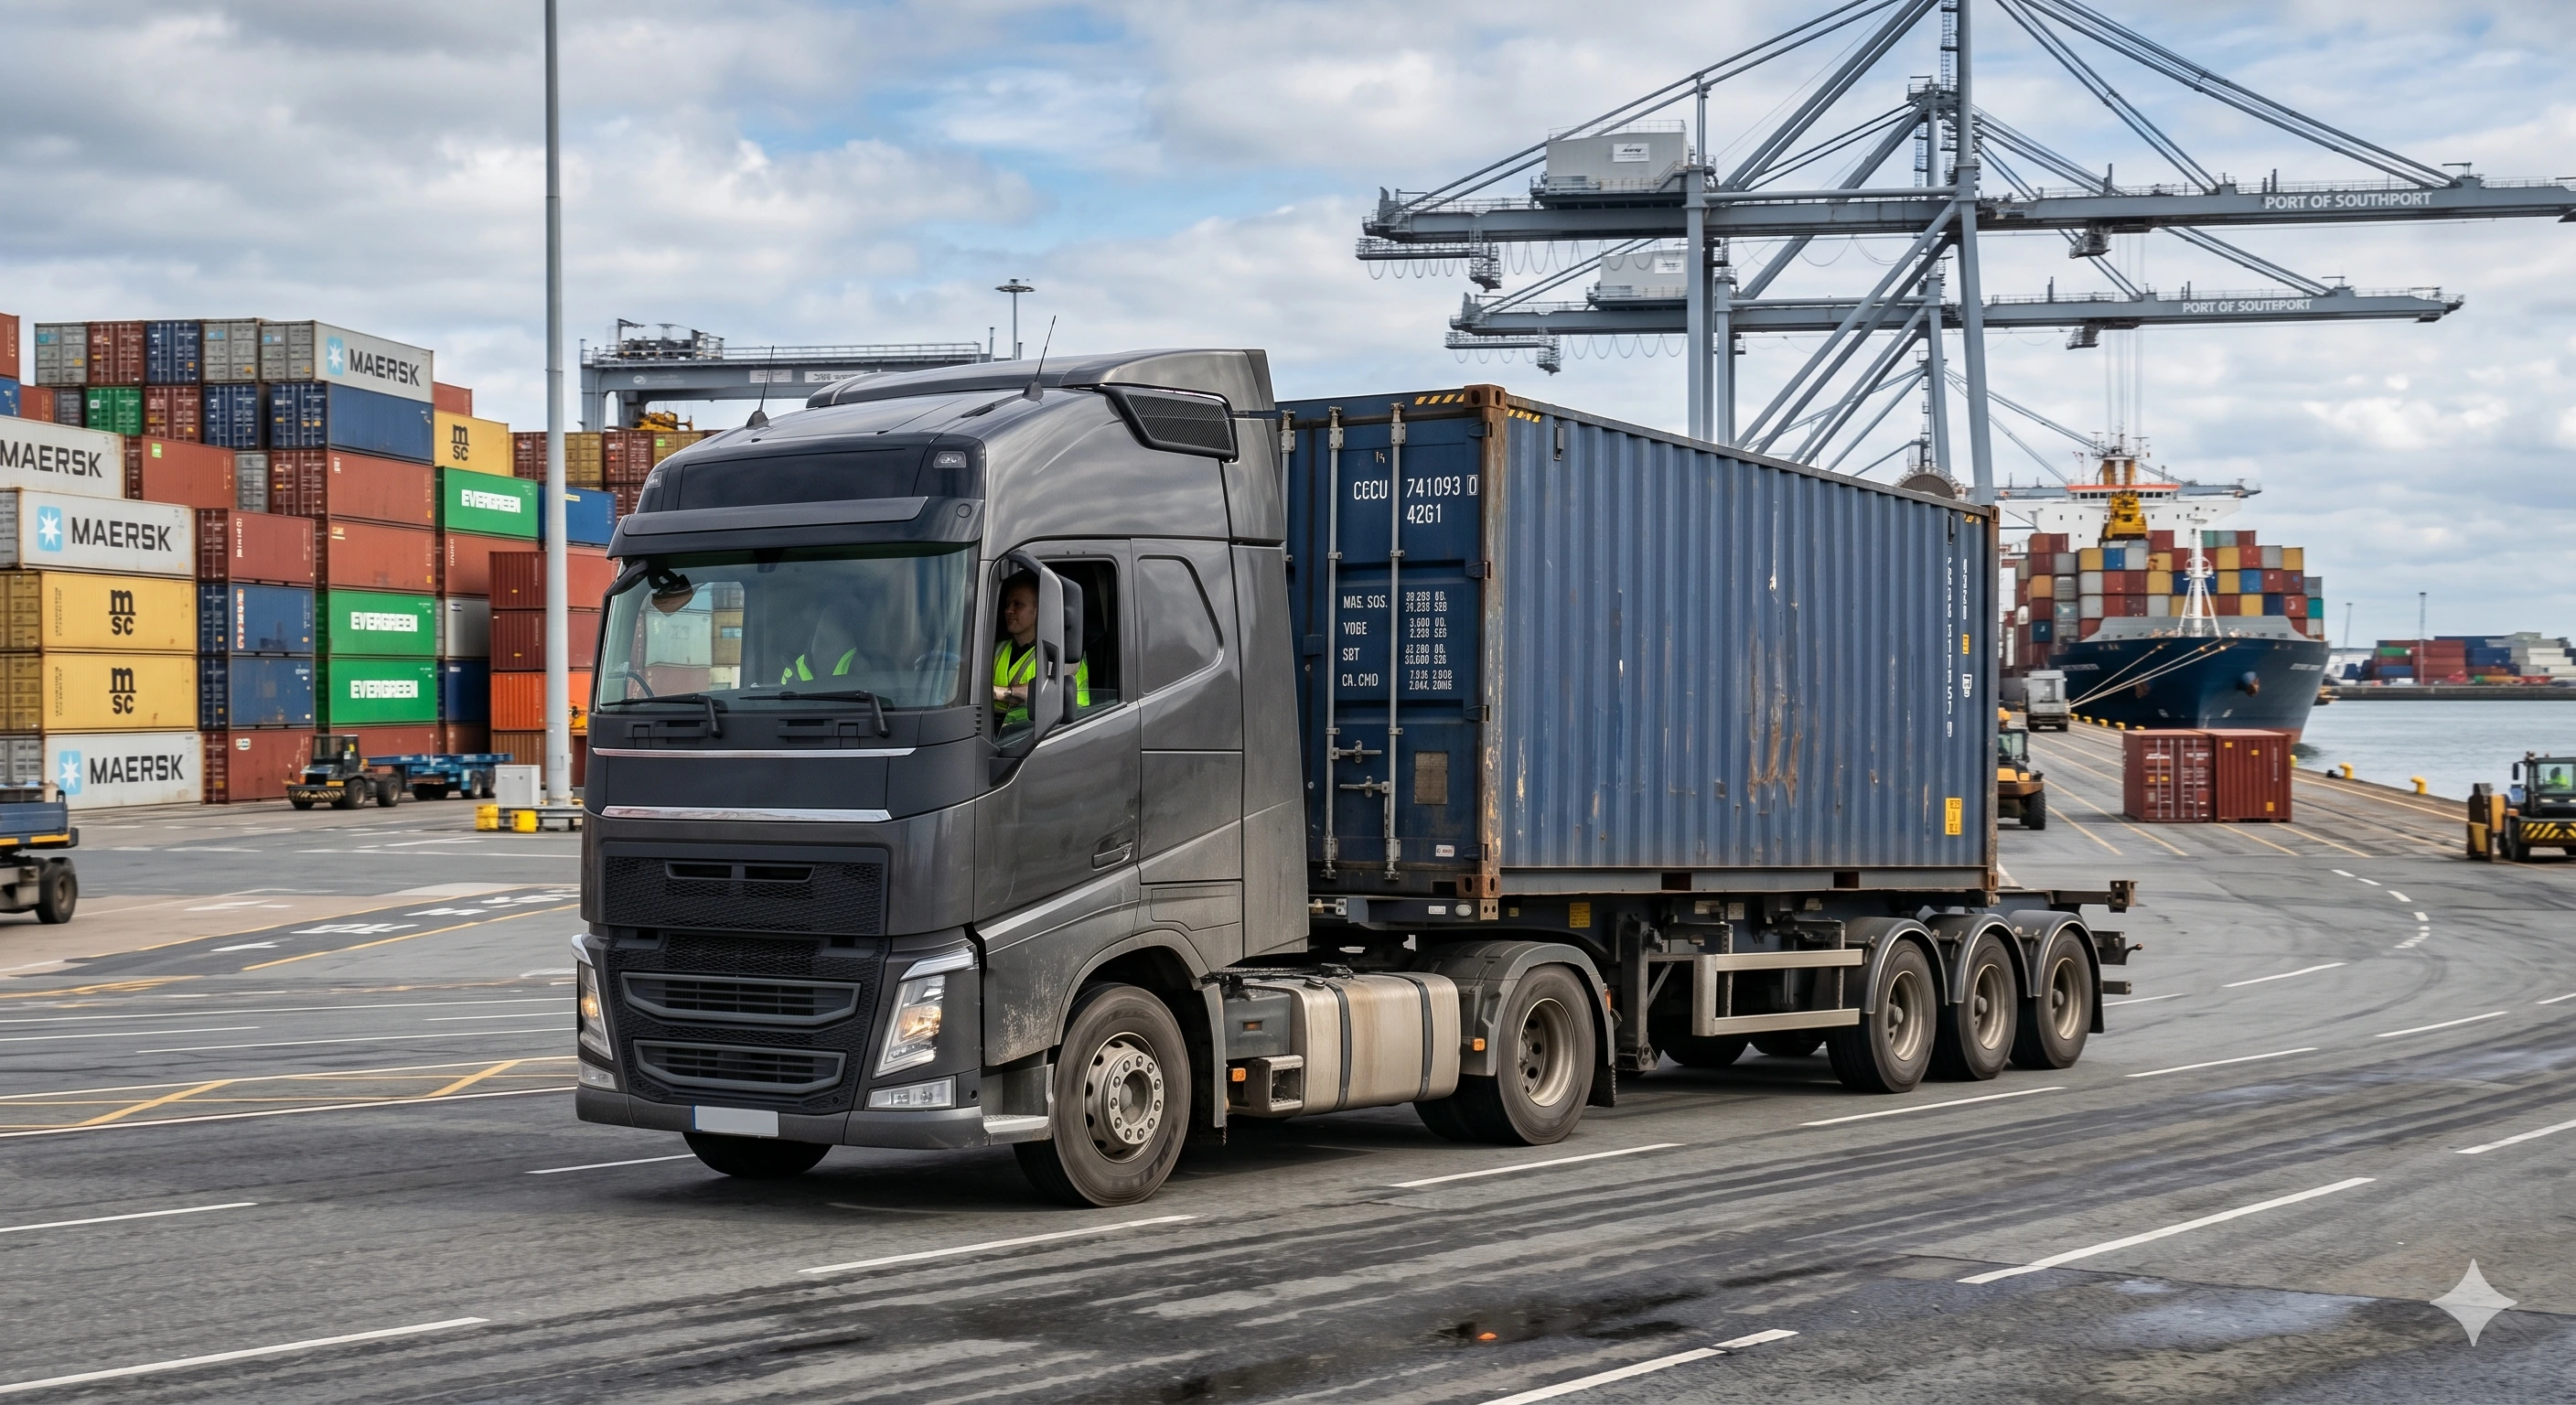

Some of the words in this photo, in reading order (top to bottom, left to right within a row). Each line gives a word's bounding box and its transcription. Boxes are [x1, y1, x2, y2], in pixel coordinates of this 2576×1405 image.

[2264, 195, 2307, 209] PORT
[2310, 195, 2332, 209] OF
[2334, 192, 2432, 208] SOUTHPORT
[2183, 302, 2216, 313] PORT
[349, 349, 421, 387] MAERSK
[0, 439, 102, 477] MAERSK
[1354, 479, 1388, 500] CECU
[1406, 476, 1461, 498] 741093
[1407, 503, 1441, 524] 42G1
[71, 517, 172, 552] MAERSK
[90, 754, 185, 785] MAERSK
